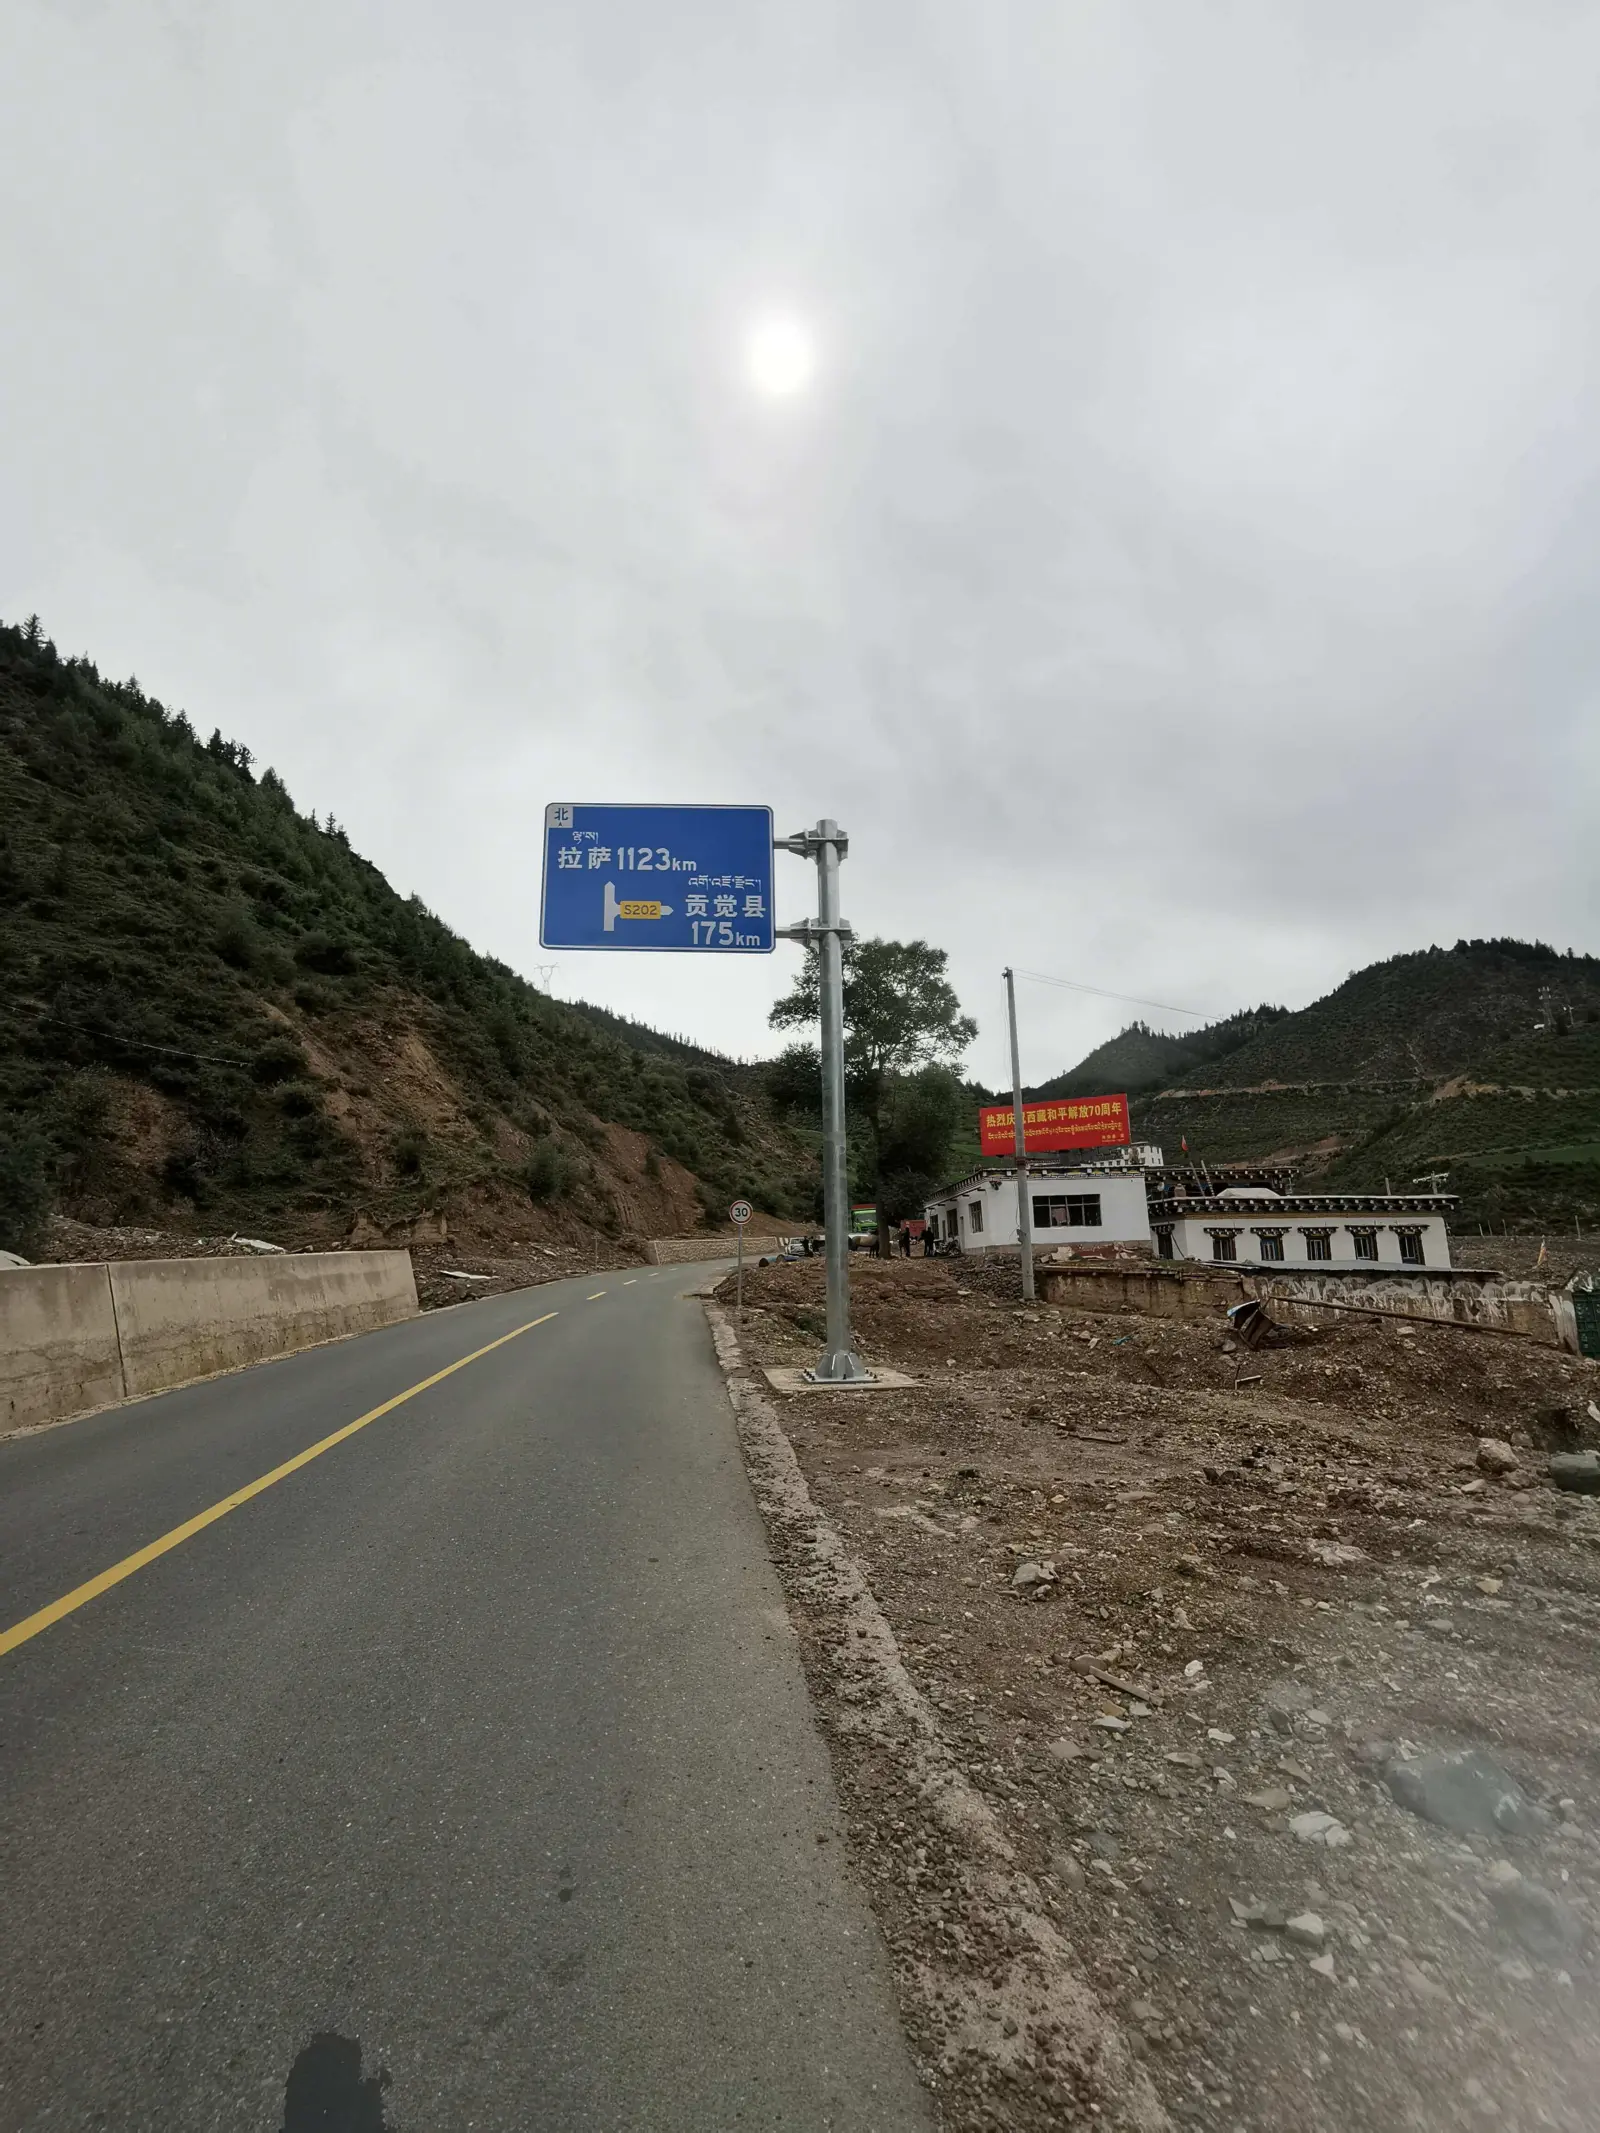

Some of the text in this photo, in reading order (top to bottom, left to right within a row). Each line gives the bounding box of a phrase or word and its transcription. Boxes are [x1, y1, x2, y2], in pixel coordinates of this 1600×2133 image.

[554, 807, 569, 821] 北
[558, 846, 612, 870] 拉萨
[623, 904, 658, 916] S202
[685, 894, 766, 919] 贡觉县
[734, 1207, 748, 1217] 30
